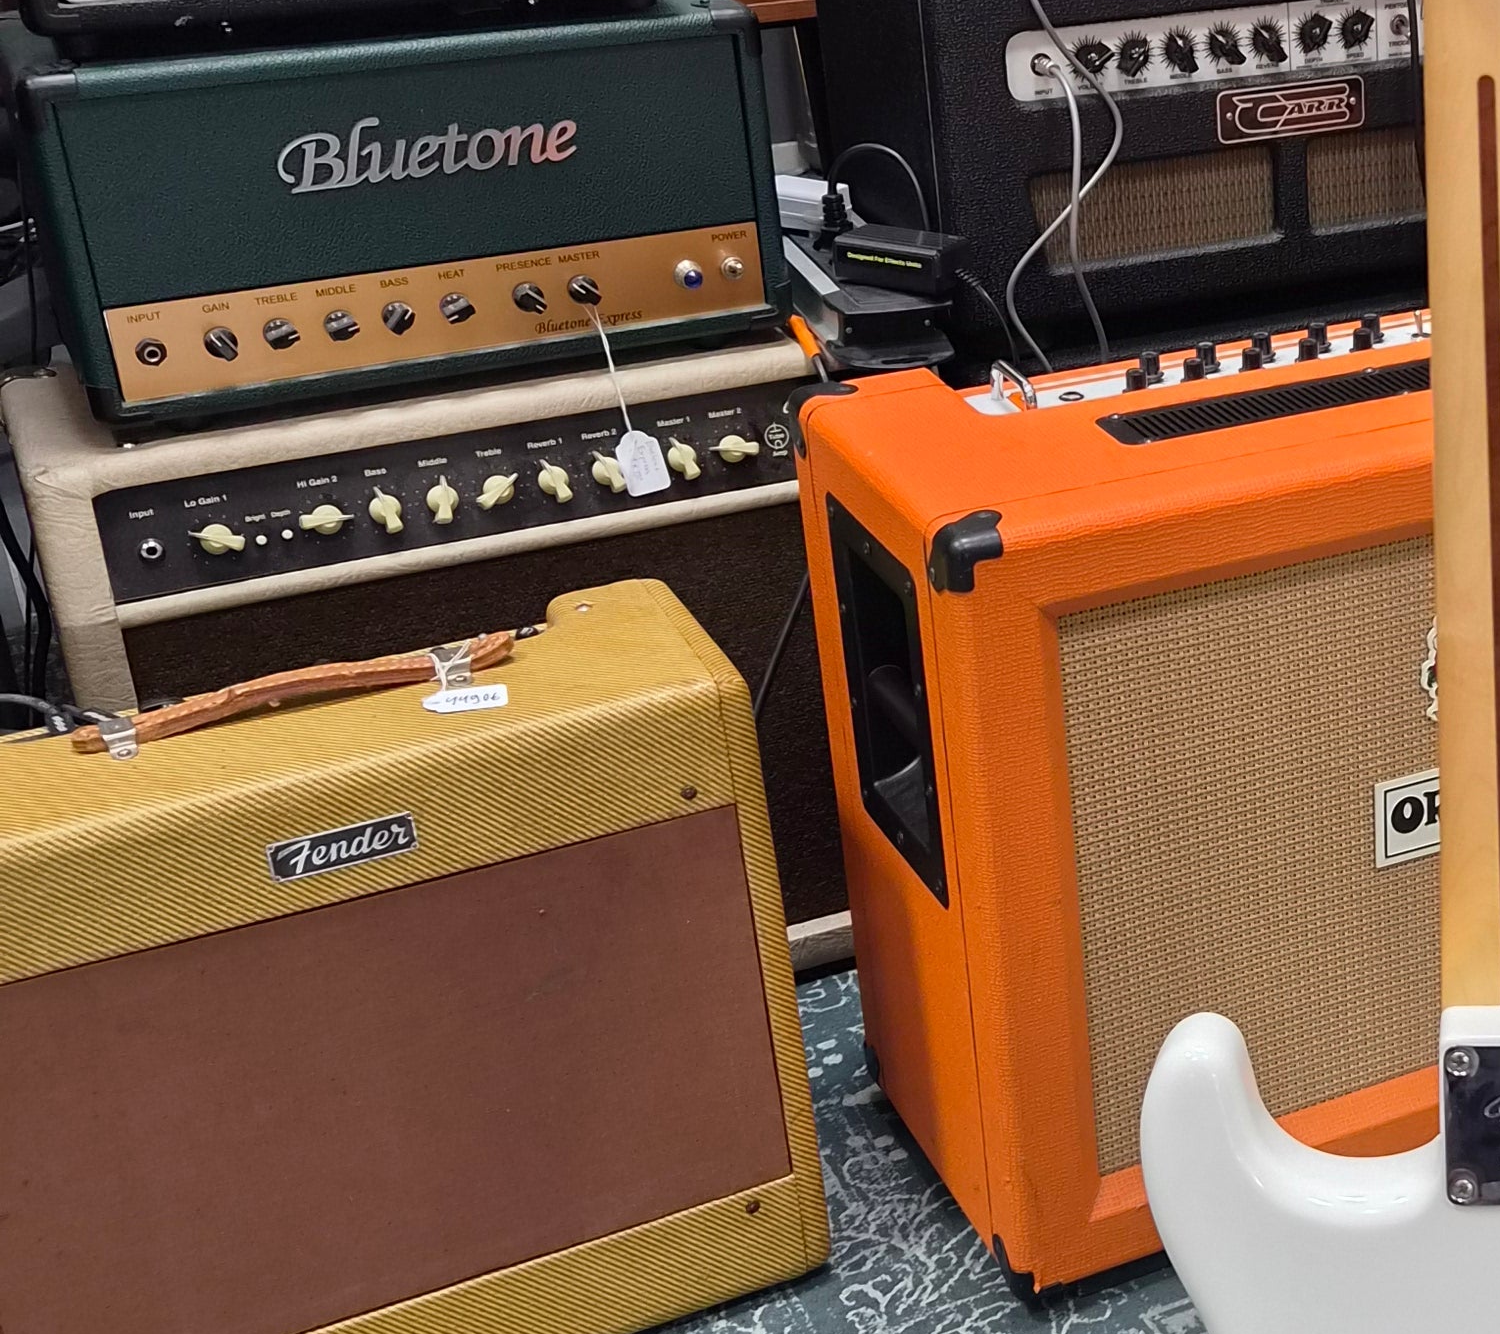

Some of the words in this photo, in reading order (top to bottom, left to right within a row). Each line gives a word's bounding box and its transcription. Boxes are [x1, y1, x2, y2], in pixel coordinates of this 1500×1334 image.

[277, 117, 577, 194] Bluetone
[711, 230, 748, 243] POWER
[558, 250, 600, 264] MASTER
[495, 257, 552, 272] PRESENCE
[438, 269, 465, 281] HEAT
[380, 277, 409, 289] BASS
[315, 284, 357, 298] MIDDLE
[254, 292, 298, 307] TREBLE
[202, 301, 230, 314] GAIN
[127, 311, 161, 324] INPUT
[535, 317, 592, 335] Bluetone
[708, 409, 735, 419] Master
[656, 418, 685, 428] Master
[581, 429, 610, 441] Reverb
[527, 438, 557, 450] Reverb
[475, 448, 502, 458] Treble
[417, 457, 448, 468] Middle
[364, 468, 387, 478] Bass
[296, 479, 307, 489] Hi
[308, 477, 331, 488] Gain
[183, 499, 196, 508] Lo
[198, 496, 221, 506] Gain
[129, 508, 154, 520] Input
[277, 822, 410, 875] Fender
